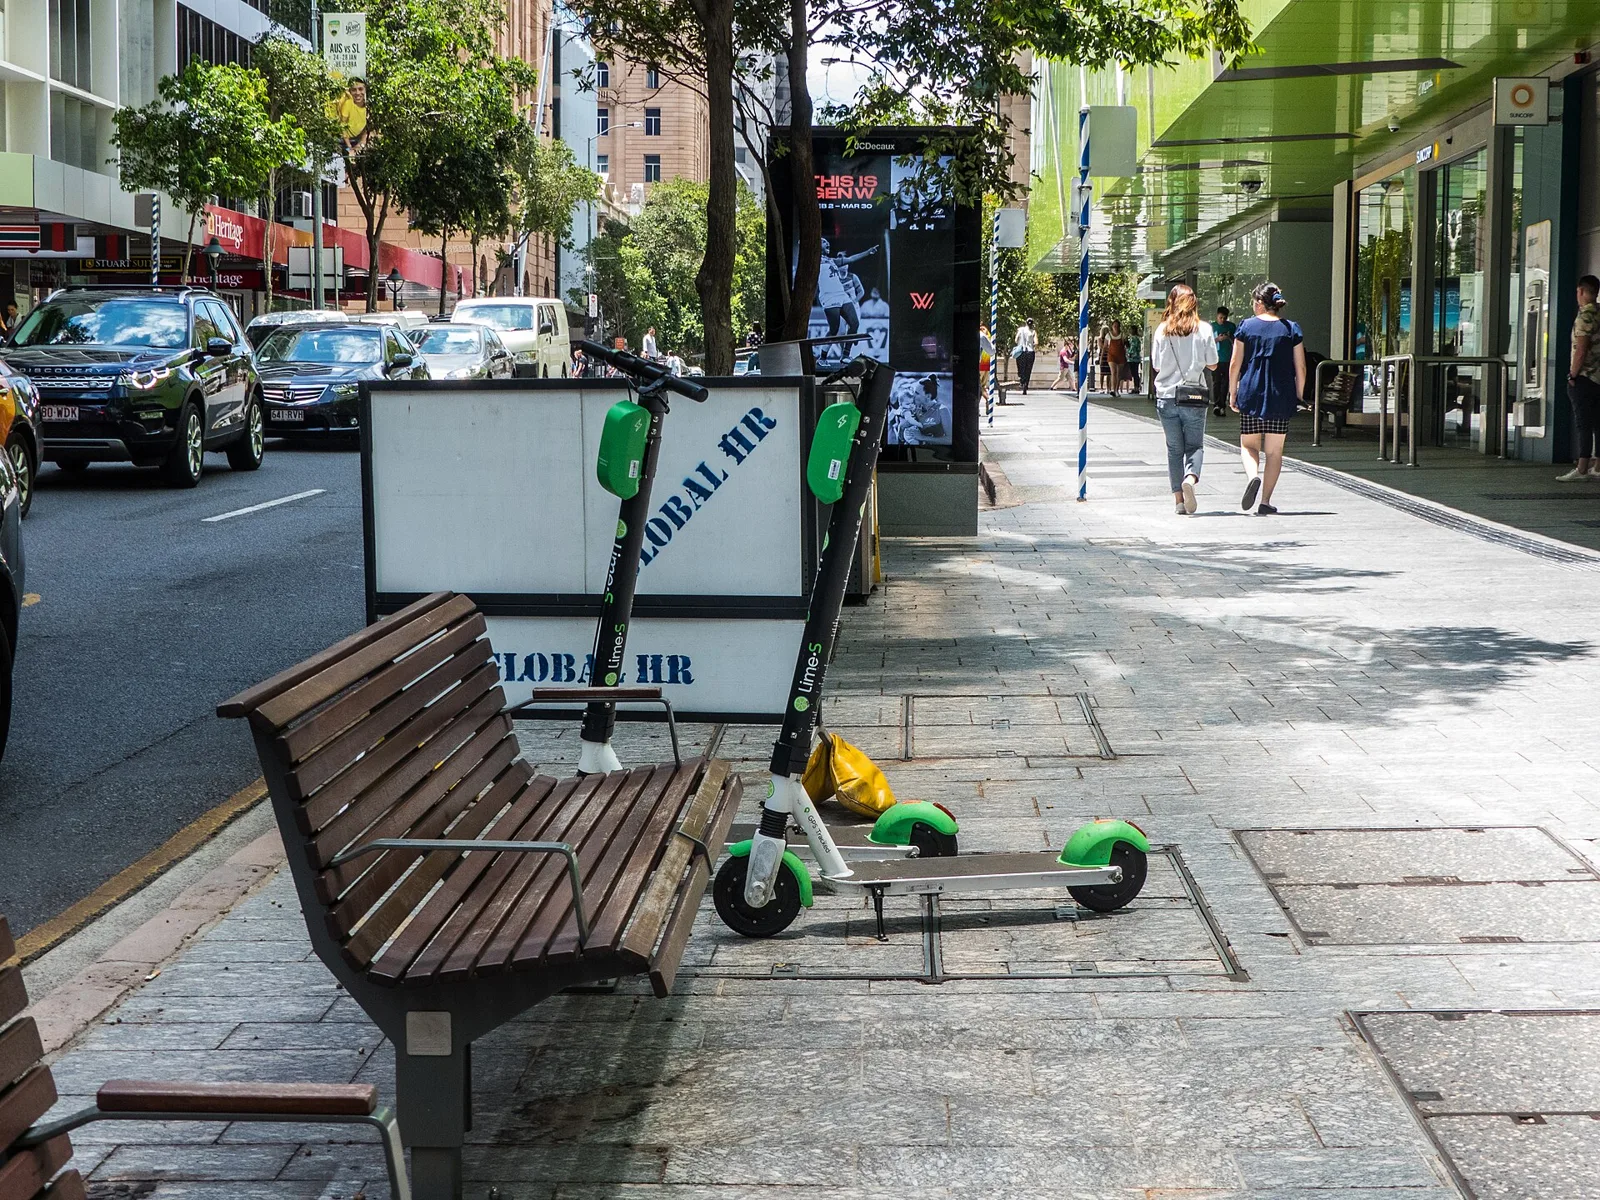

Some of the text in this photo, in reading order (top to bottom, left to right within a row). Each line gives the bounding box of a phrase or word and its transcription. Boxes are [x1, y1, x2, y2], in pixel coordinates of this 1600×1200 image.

[329, 43, 343, 53] AUS
[352, 43, 360, 53] SL
[854, 142, 895, 150] JCDecaux
[859, 175, 878, 187] IS
[214, 214, 243, 249] Heritage
[95, 259, 131, 268] STUART
[636, 407, 777, 576] LOBAL HR
[636, 654, 695, 685] HR
[807, 815, 831, 853] GPS Tracked
